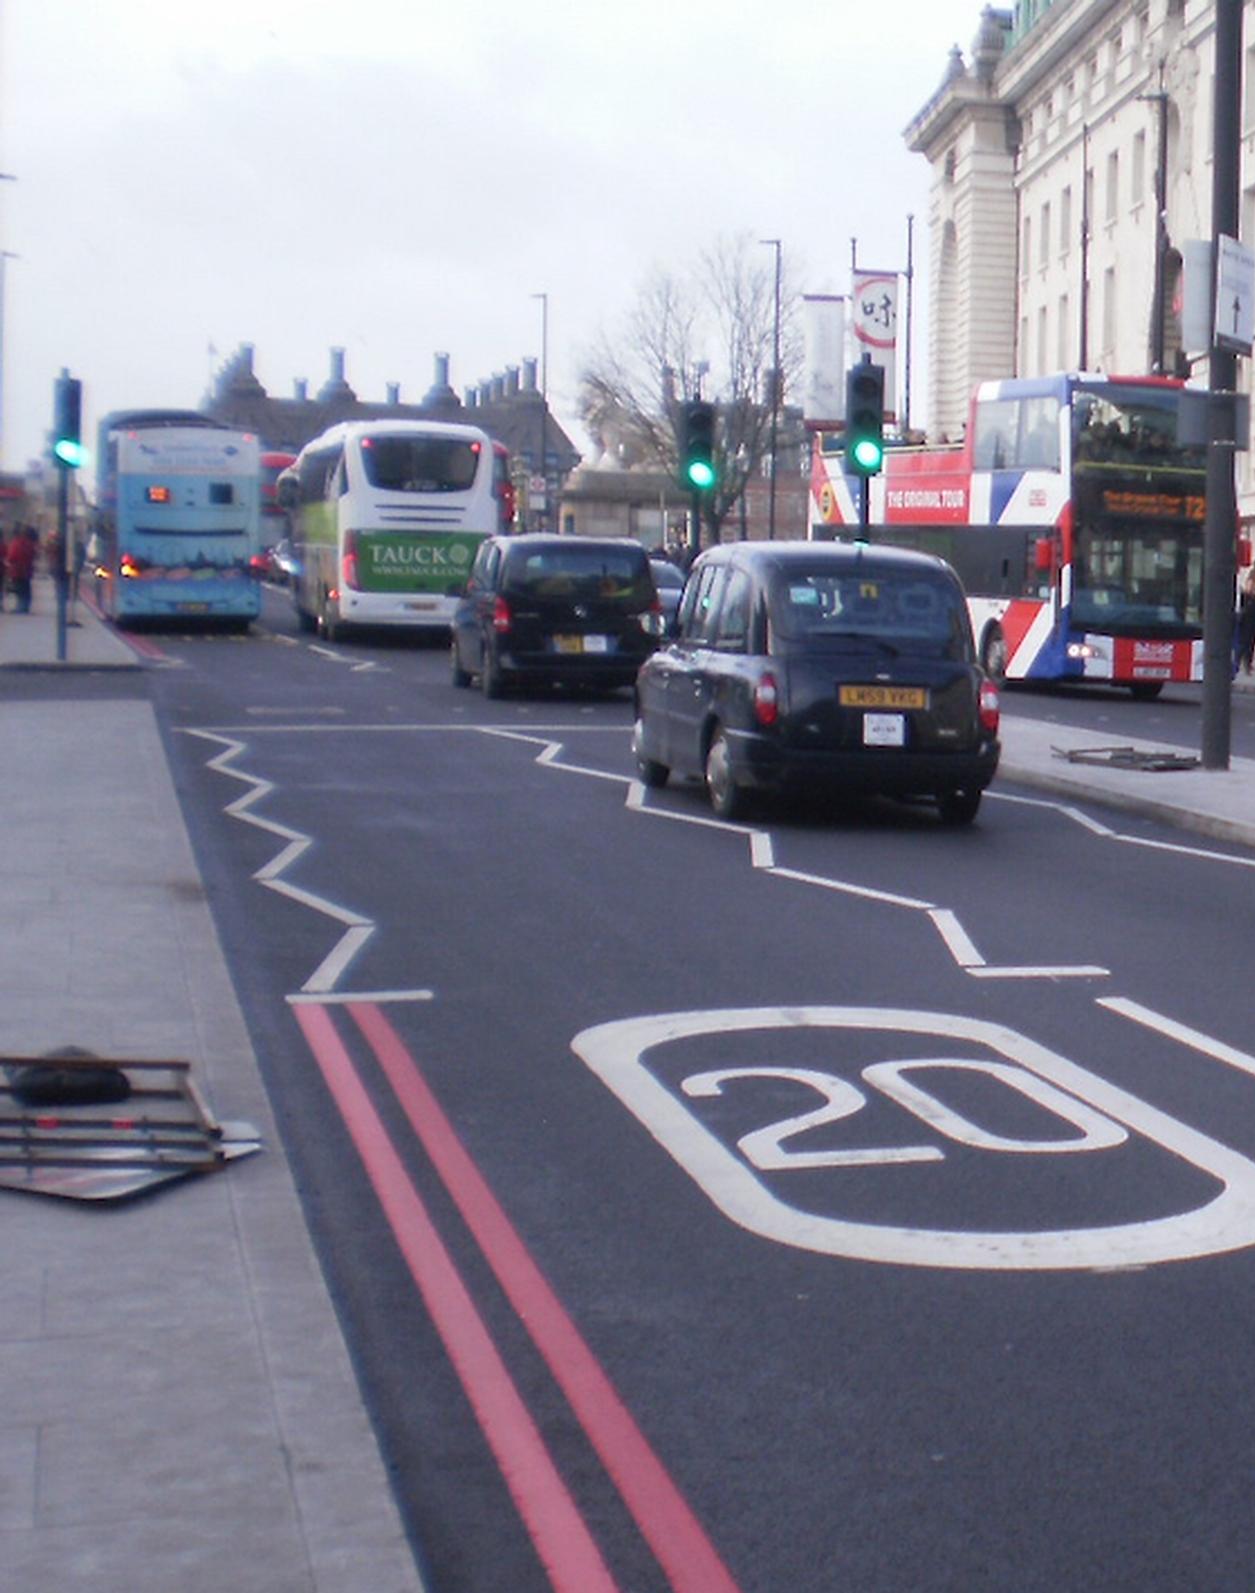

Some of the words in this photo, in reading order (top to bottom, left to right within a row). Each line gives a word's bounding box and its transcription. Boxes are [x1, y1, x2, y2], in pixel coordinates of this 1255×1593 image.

[888, 490, 902, 507] THE
[904, 490, 941, 507] ORIGINAL
[942, 489, 964, 507] TOUR
[368, 544, 447, 564] TAUCK
[682, 1058, 1129, 1170] 20
